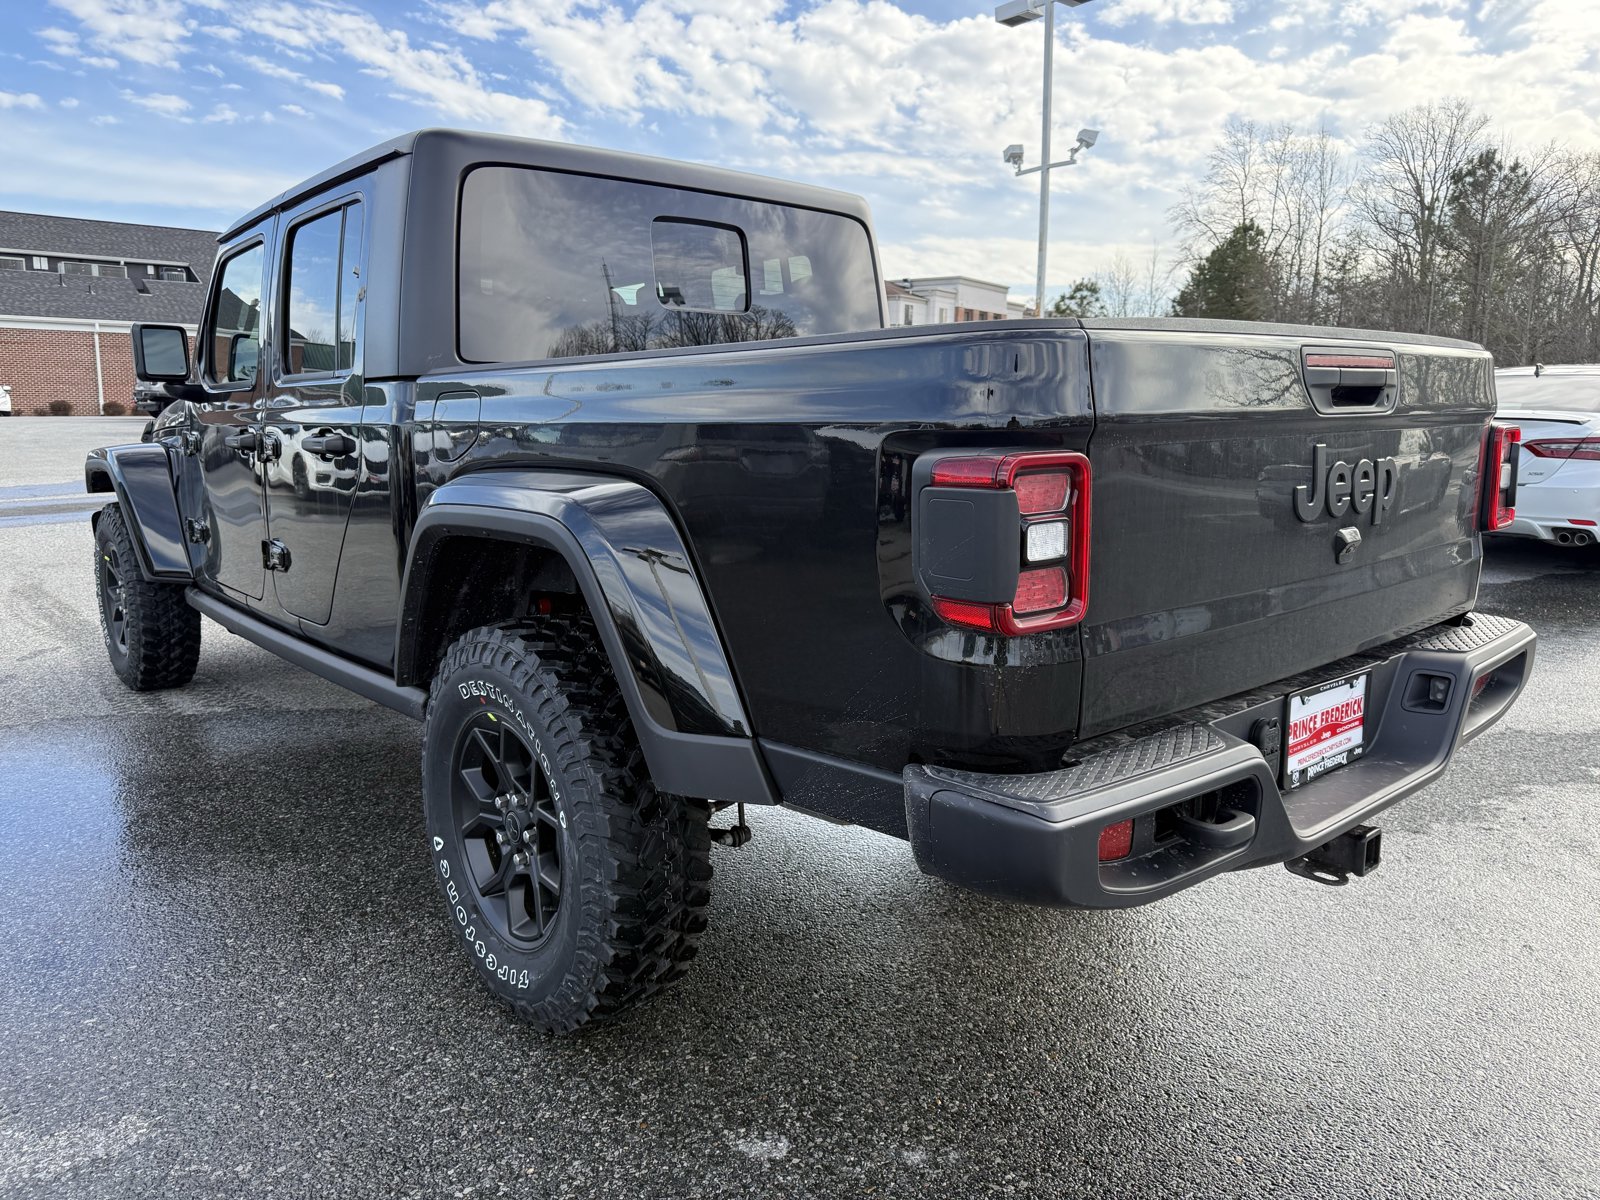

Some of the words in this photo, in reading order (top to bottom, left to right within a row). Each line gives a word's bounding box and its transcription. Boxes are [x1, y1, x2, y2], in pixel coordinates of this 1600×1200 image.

[1294, 444, 1397, 525] Jeep
[1320, 680, 1345, 691] CHRYSLER
[1289, 714, 1317, 740] PRINCE
[1321, 697, 1362, 726] FREDERICK
[458, 680, 560, 801] DESTINATION
[1289, 739, 1317, 753] CHRYSLER
[1321, 731, 1332, 740] Jeep
[1354, 747, 1363, 755] Jeep
[1308, 761, 1325, 780] PRINCE
[1325, 752, 1348, 769] FREDERICK
[440, 859, 529, 989] Firestone
